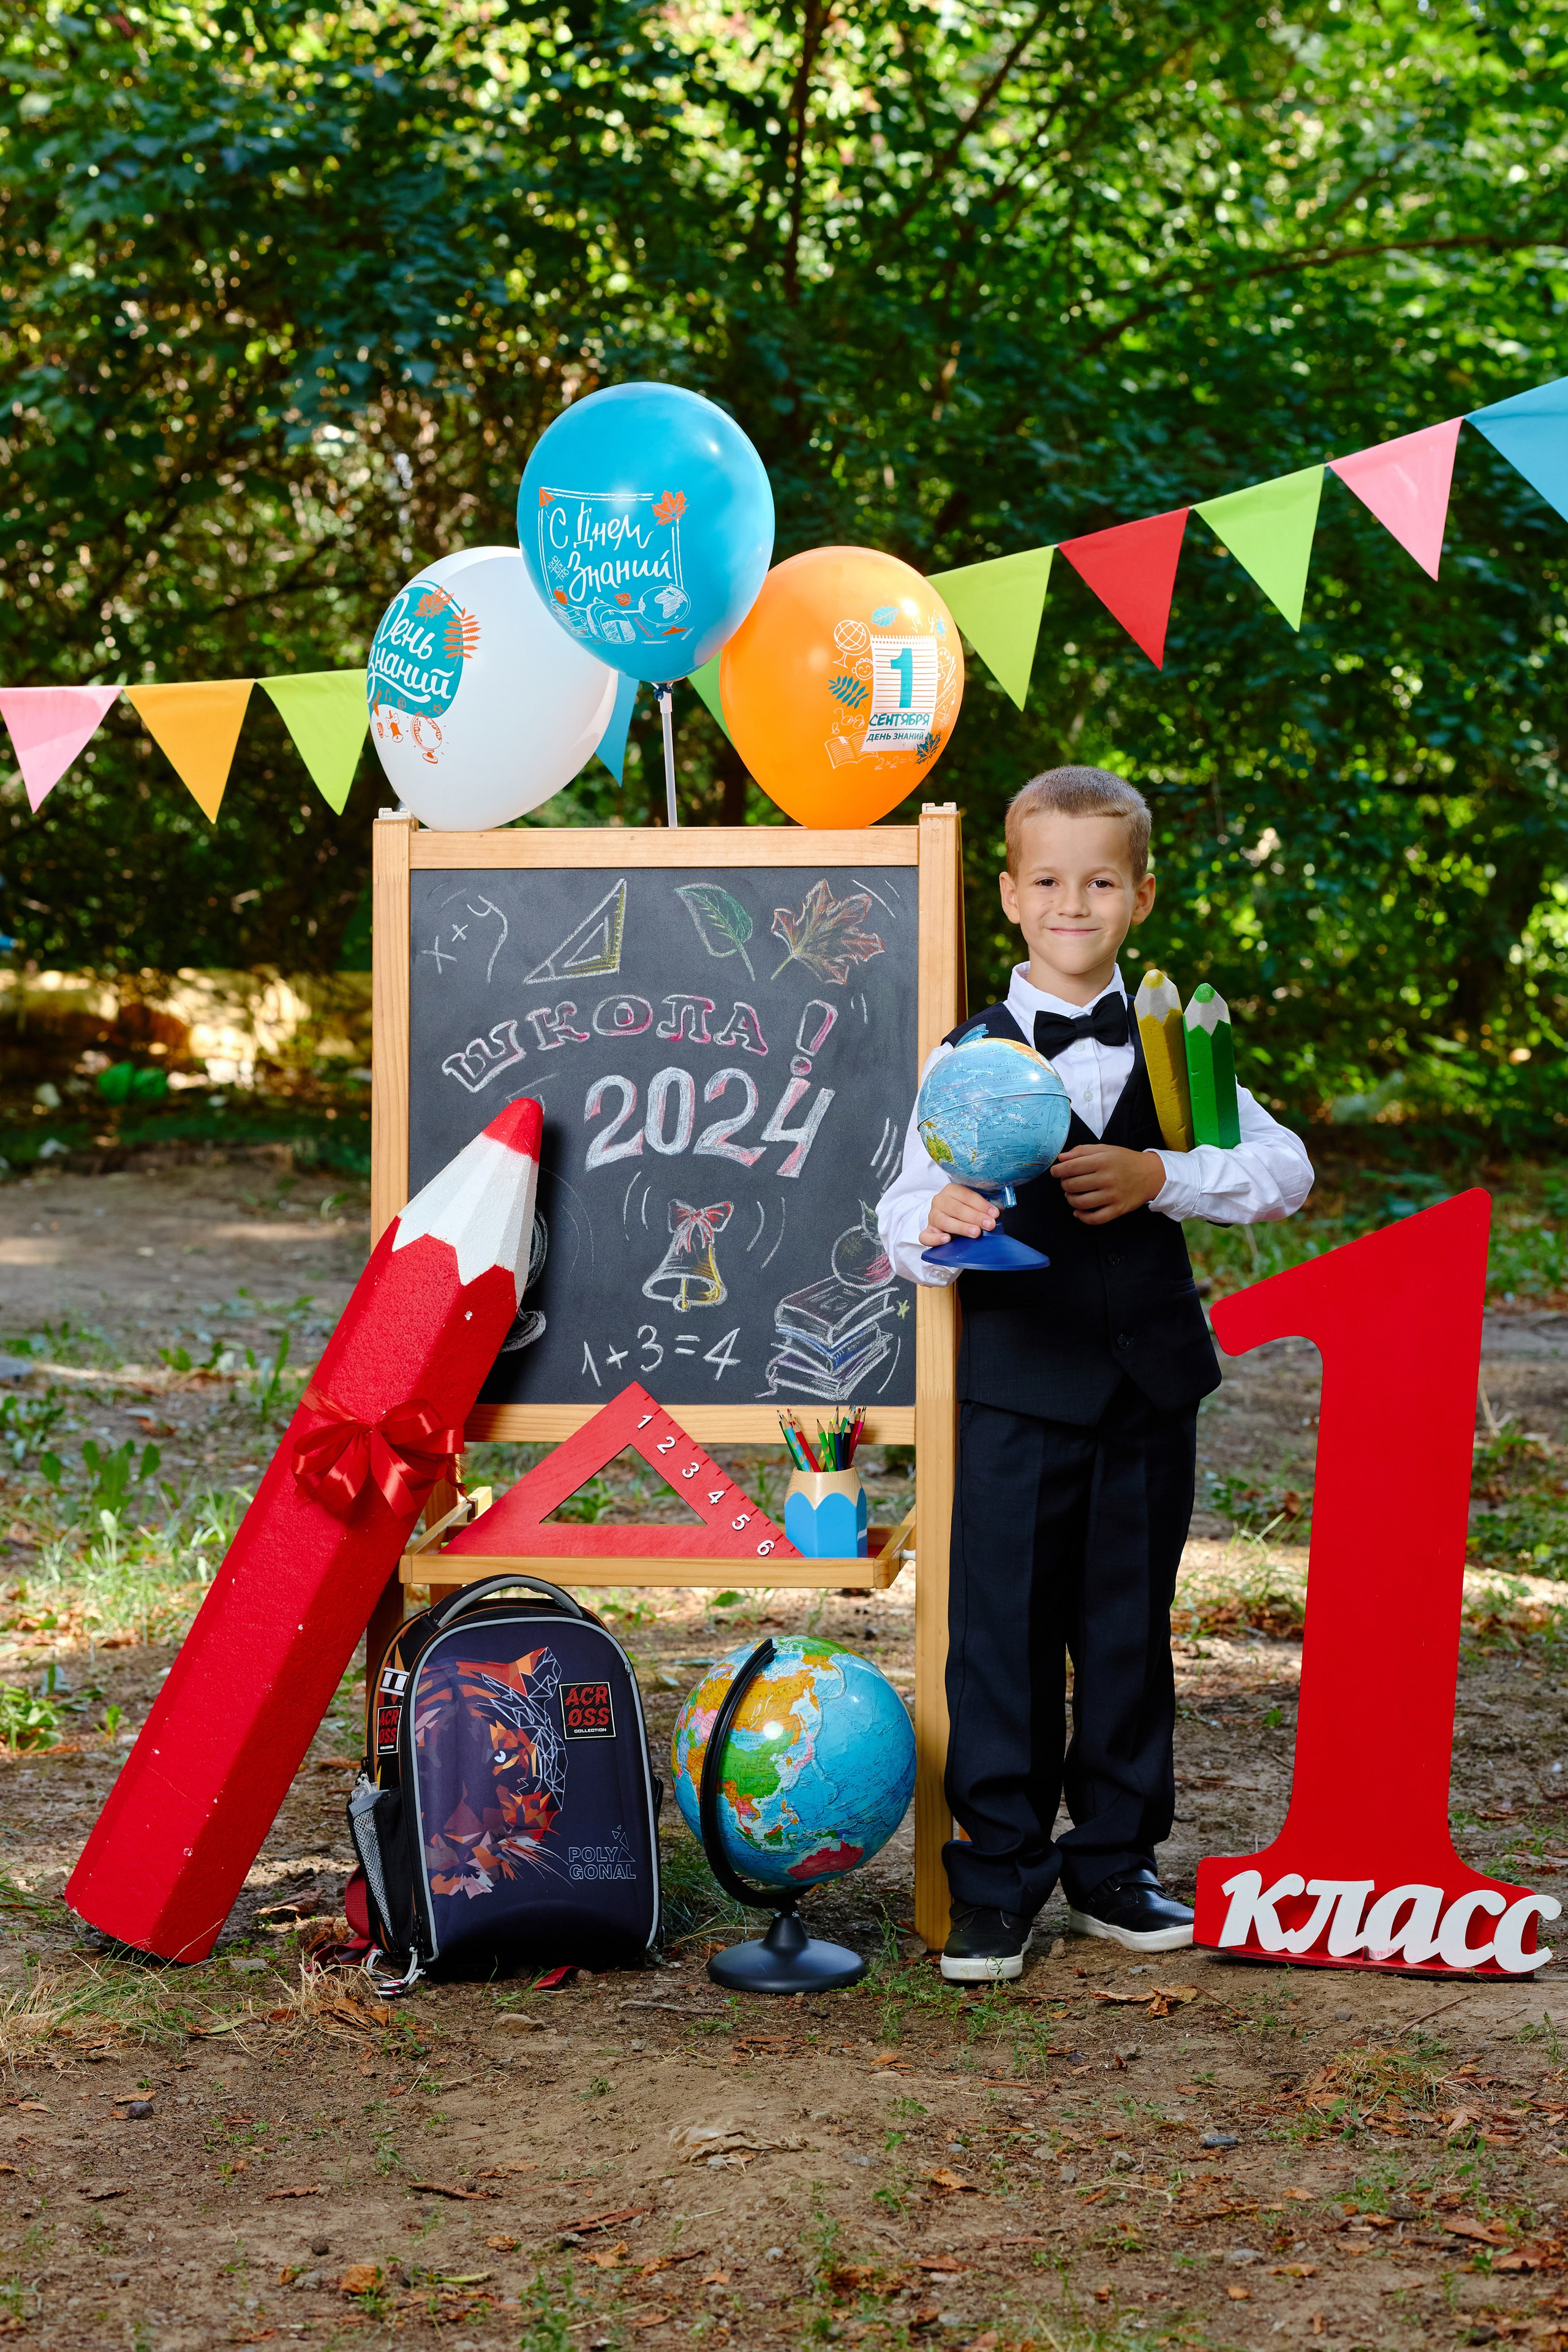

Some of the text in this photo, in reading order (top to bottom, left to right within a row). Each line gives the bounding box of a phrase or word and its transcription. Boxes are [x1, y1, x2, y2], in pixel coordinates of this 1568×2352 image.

[550, 502, 654, 551] С Днем
[567, 549, 673, 602] Знаний
[378, 592, 435, 660] День
[367, 645, 451, 703] Знаний
[890, 647, 913, 709] 1
[866, 731, 924, 742] ДЕНЬ ЗНАНИЙ
[869, 712, 930, 727] СЕНТЯБРЯ
[442, 993, 839, 1094] ШКОЛА!
[583, 1066, 837, 1179] 2024
[637, 1414, 775, 1556] 1 2 3 4 5 6
[1194, 1187, 1538, 1980] 1
[379, 1708, 399, 1727] ACR
[564, 1684, 608, 1708] ACR
[568, 1846, 619, 1862] POLY
[569, 1864, 636, 1880] GONAL
